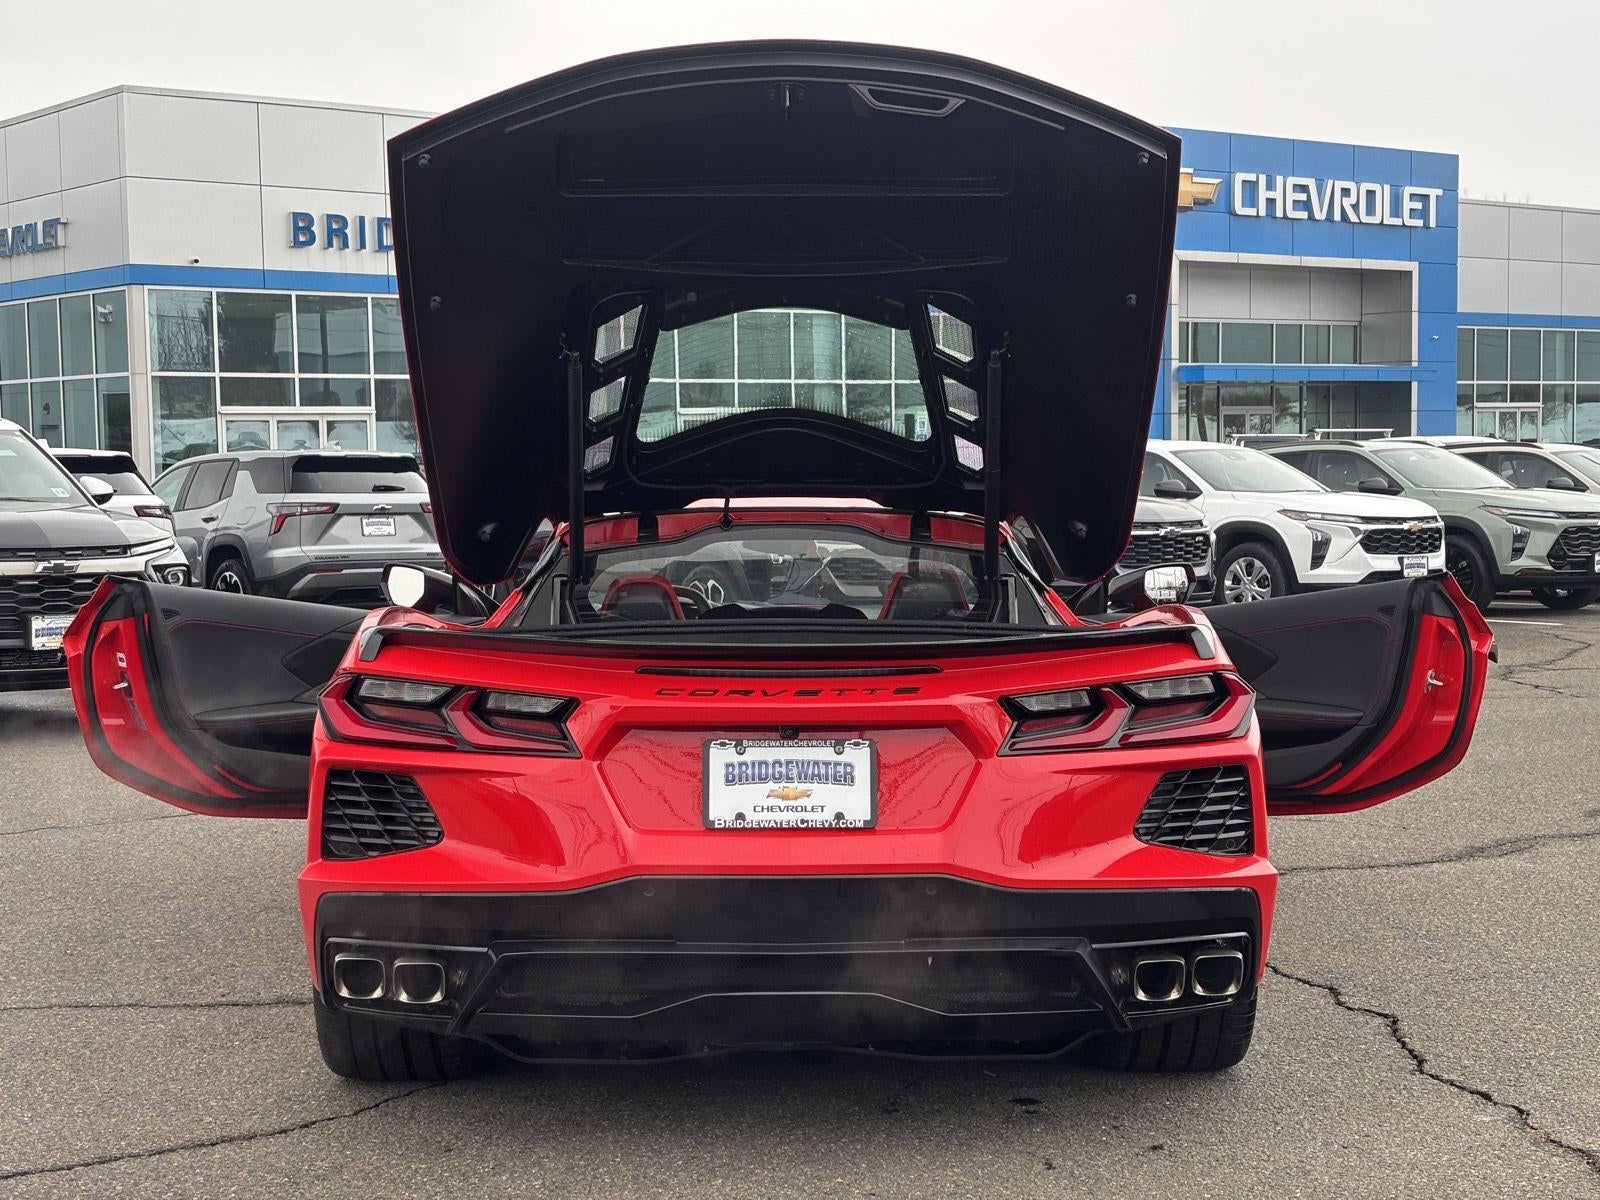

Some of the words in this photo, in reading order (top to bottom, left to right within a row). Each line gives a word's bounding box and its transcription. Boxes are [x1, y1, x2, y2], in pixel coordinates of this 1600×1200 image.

[1234, 172, 1444, 228] CHEVROLET
[655, 686, 922, 697] CORVETTE
[724, 759, 856, 786] BRIDGEWATER
[753, 805, 826, 813] CHEVROLET
